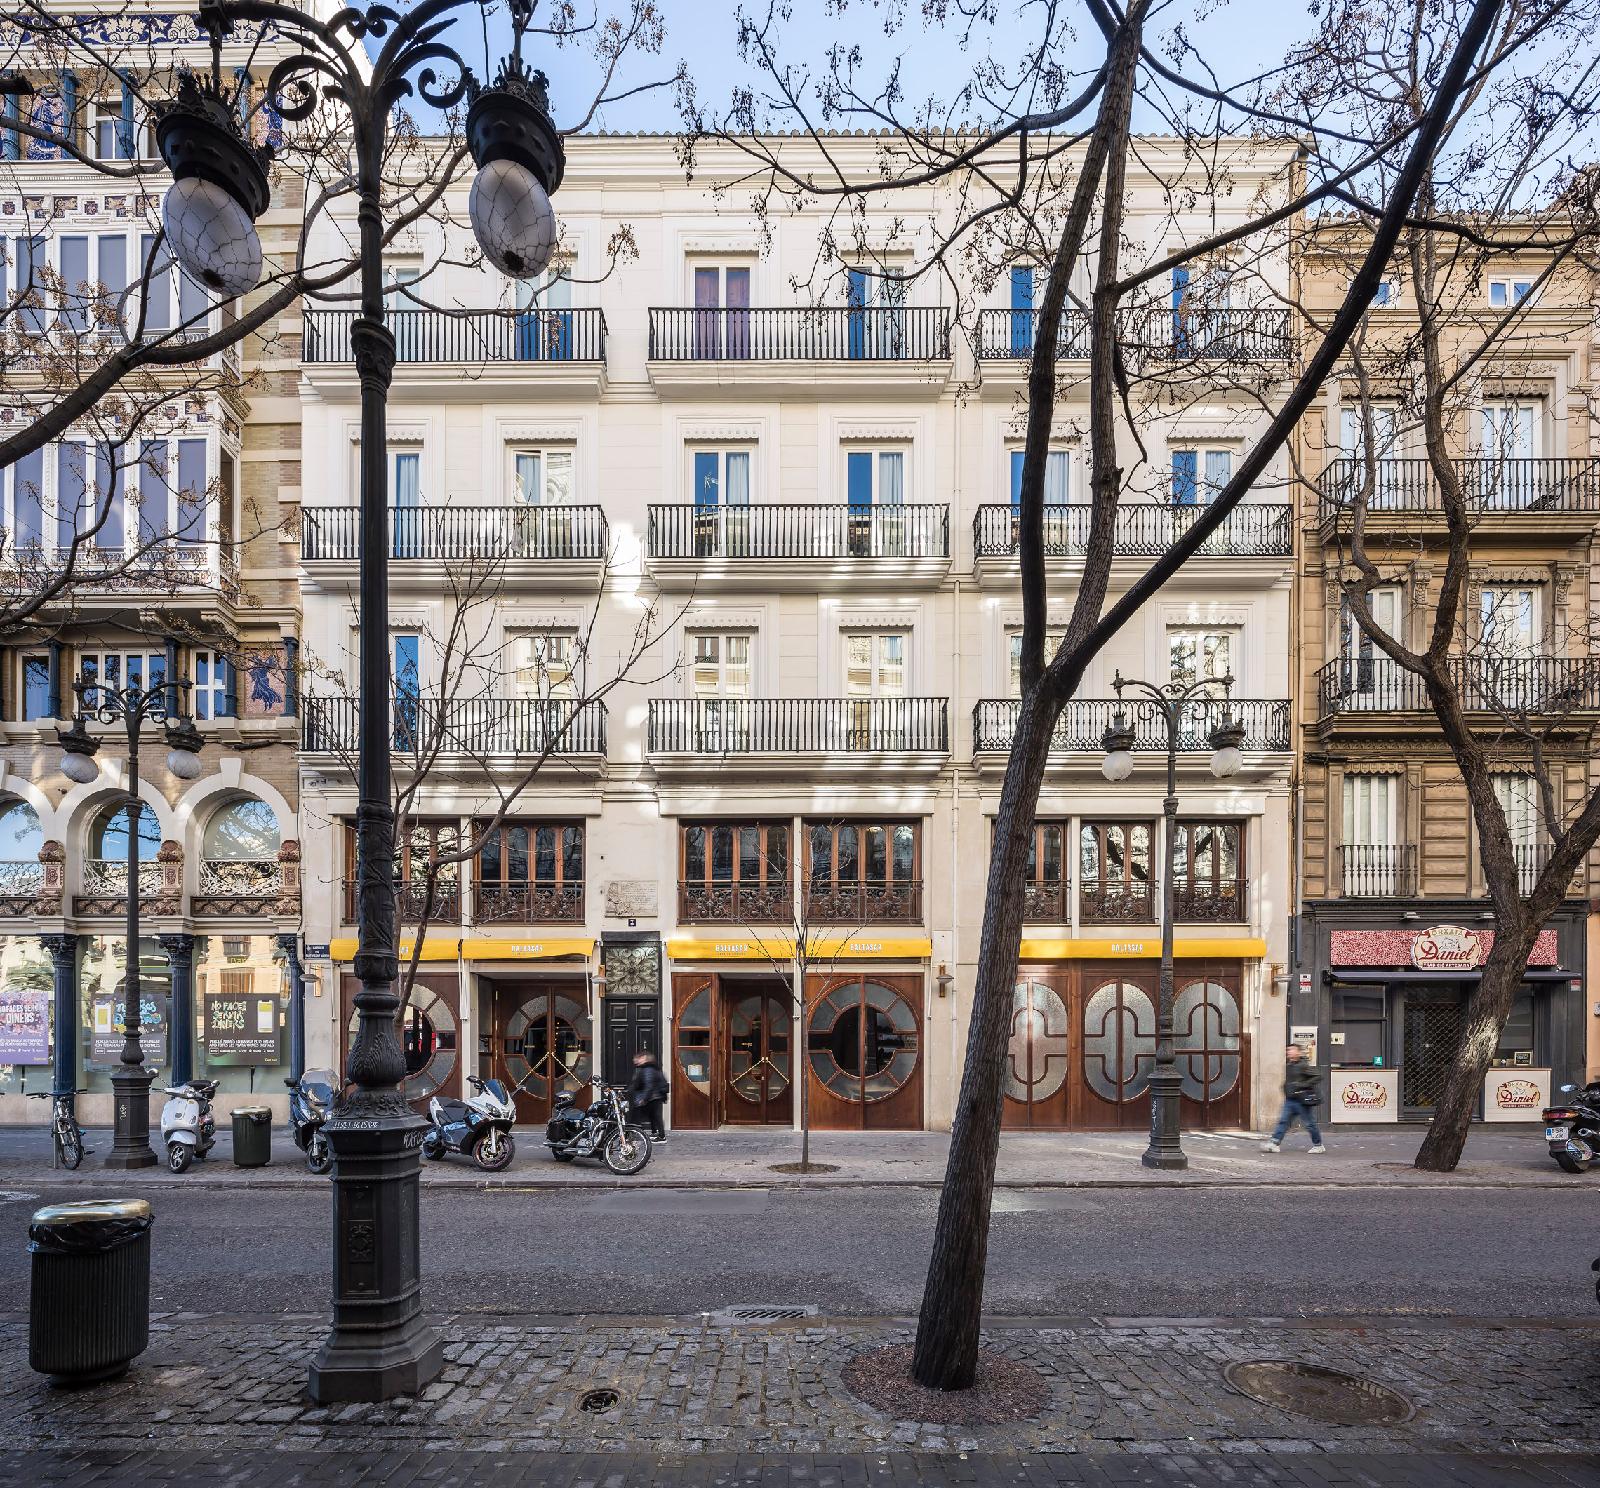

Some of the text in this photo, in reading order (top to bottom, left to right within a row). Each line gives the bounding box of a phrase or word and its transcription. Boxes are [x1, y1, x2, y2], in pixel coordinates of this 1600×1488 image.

[1418, 940, 1476, 961] Daniel
[211, 1000, 222, 1011] NO
[7, 1012, 35, 1024] DINERS
[1346, 1090, 1384, 1105] Daniel
[1500, 1089, 1538, 1103] Daniel
